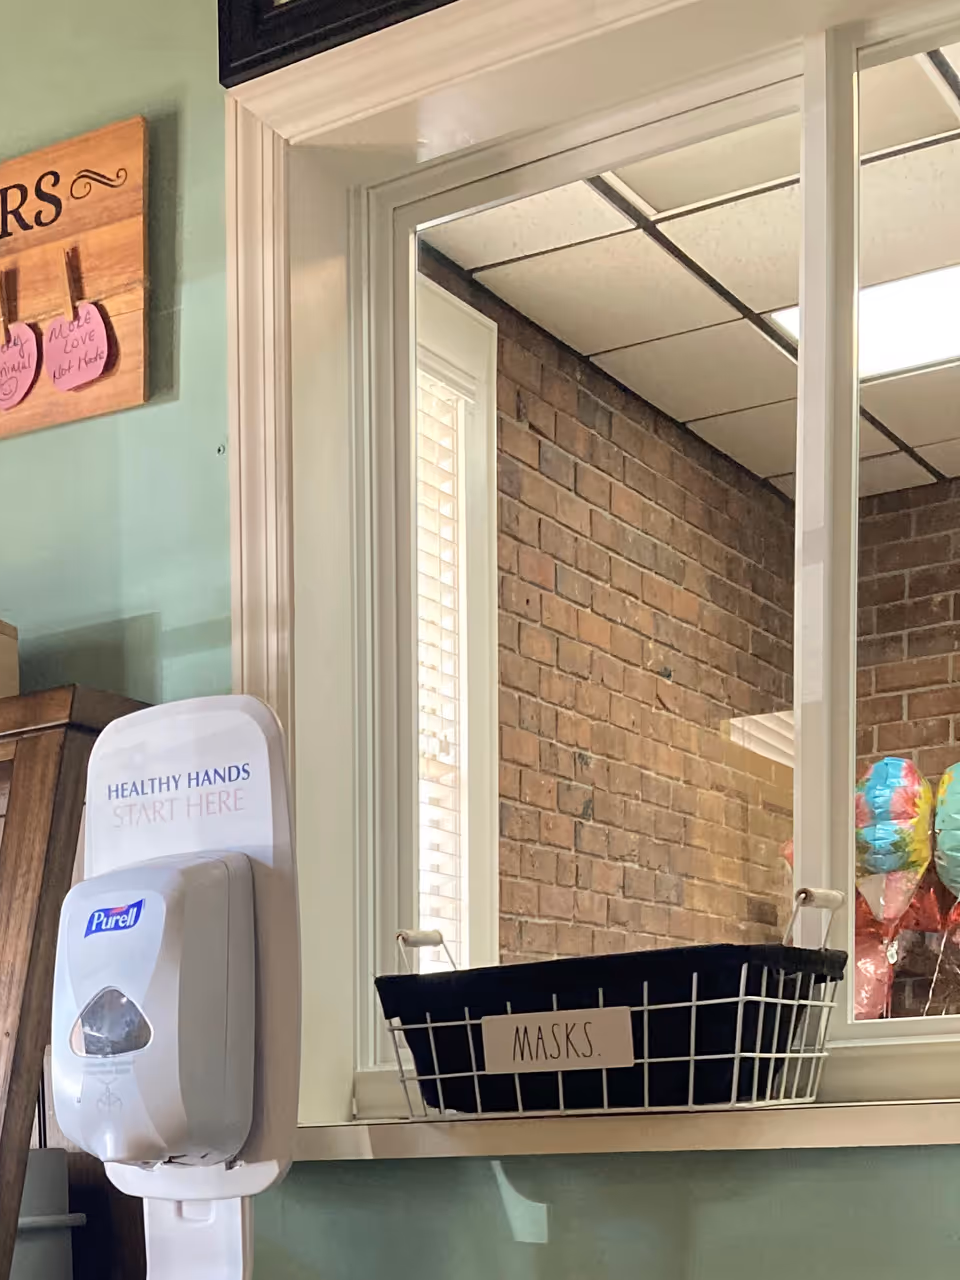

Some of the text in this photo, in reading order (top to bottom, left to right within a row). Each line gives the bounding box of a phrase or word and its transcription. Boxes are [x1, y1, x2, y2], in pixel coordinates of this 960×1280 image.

[108, 762, 251, 800] HEALTHY HANDS
[113, 788, 245, 828] START HERE
[92, 906, 138, 931] Purell
